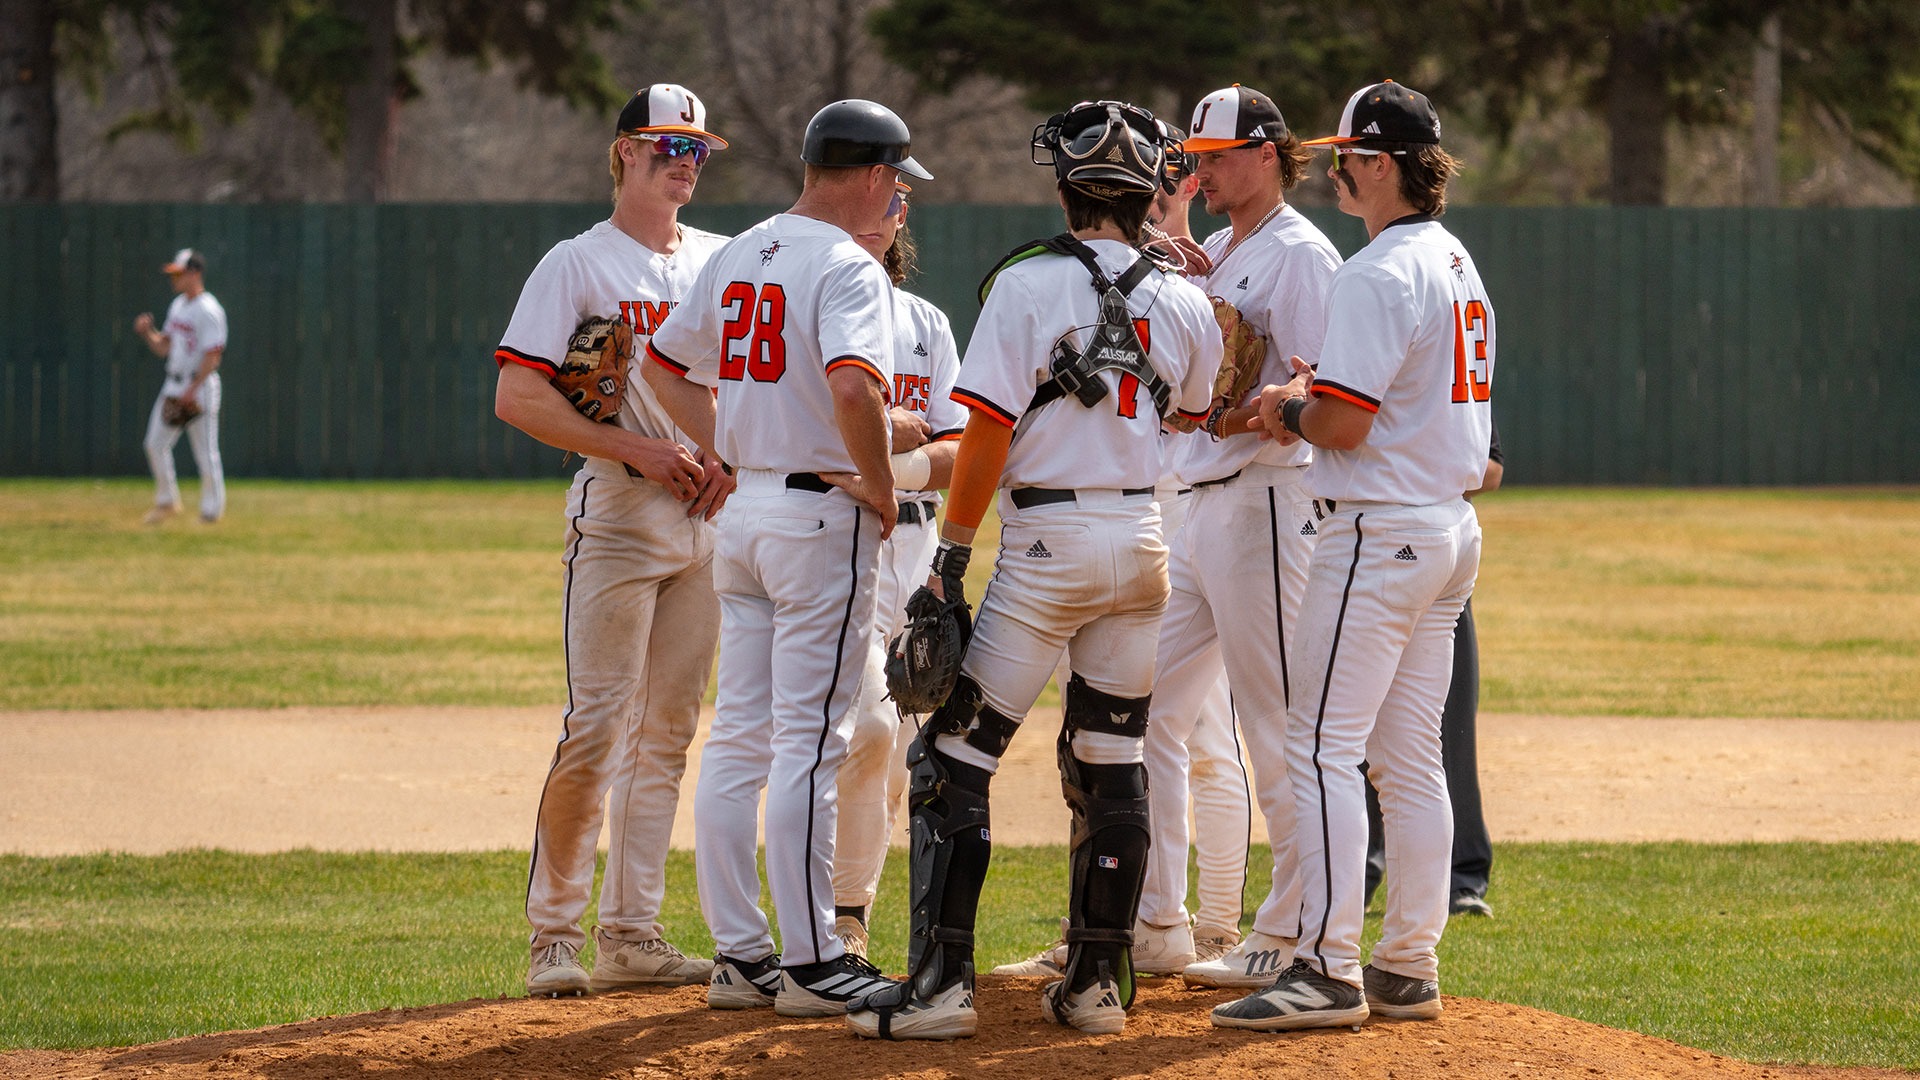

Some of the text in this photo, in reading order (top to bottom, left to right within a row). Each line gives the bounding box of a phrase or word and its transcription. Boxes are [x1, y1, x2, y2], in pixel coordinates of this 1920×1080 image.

[680, 95, 695, 123] J
[1193, 103, 1211, 134] J
[619, 301, 679, 335] JIM
[718, 281, 787, 383] 28
[1451, 300, 1491, 404] 13
[1025, 550, 1052, 558] adidas
[1394, 553, 1418, 561] adidas
